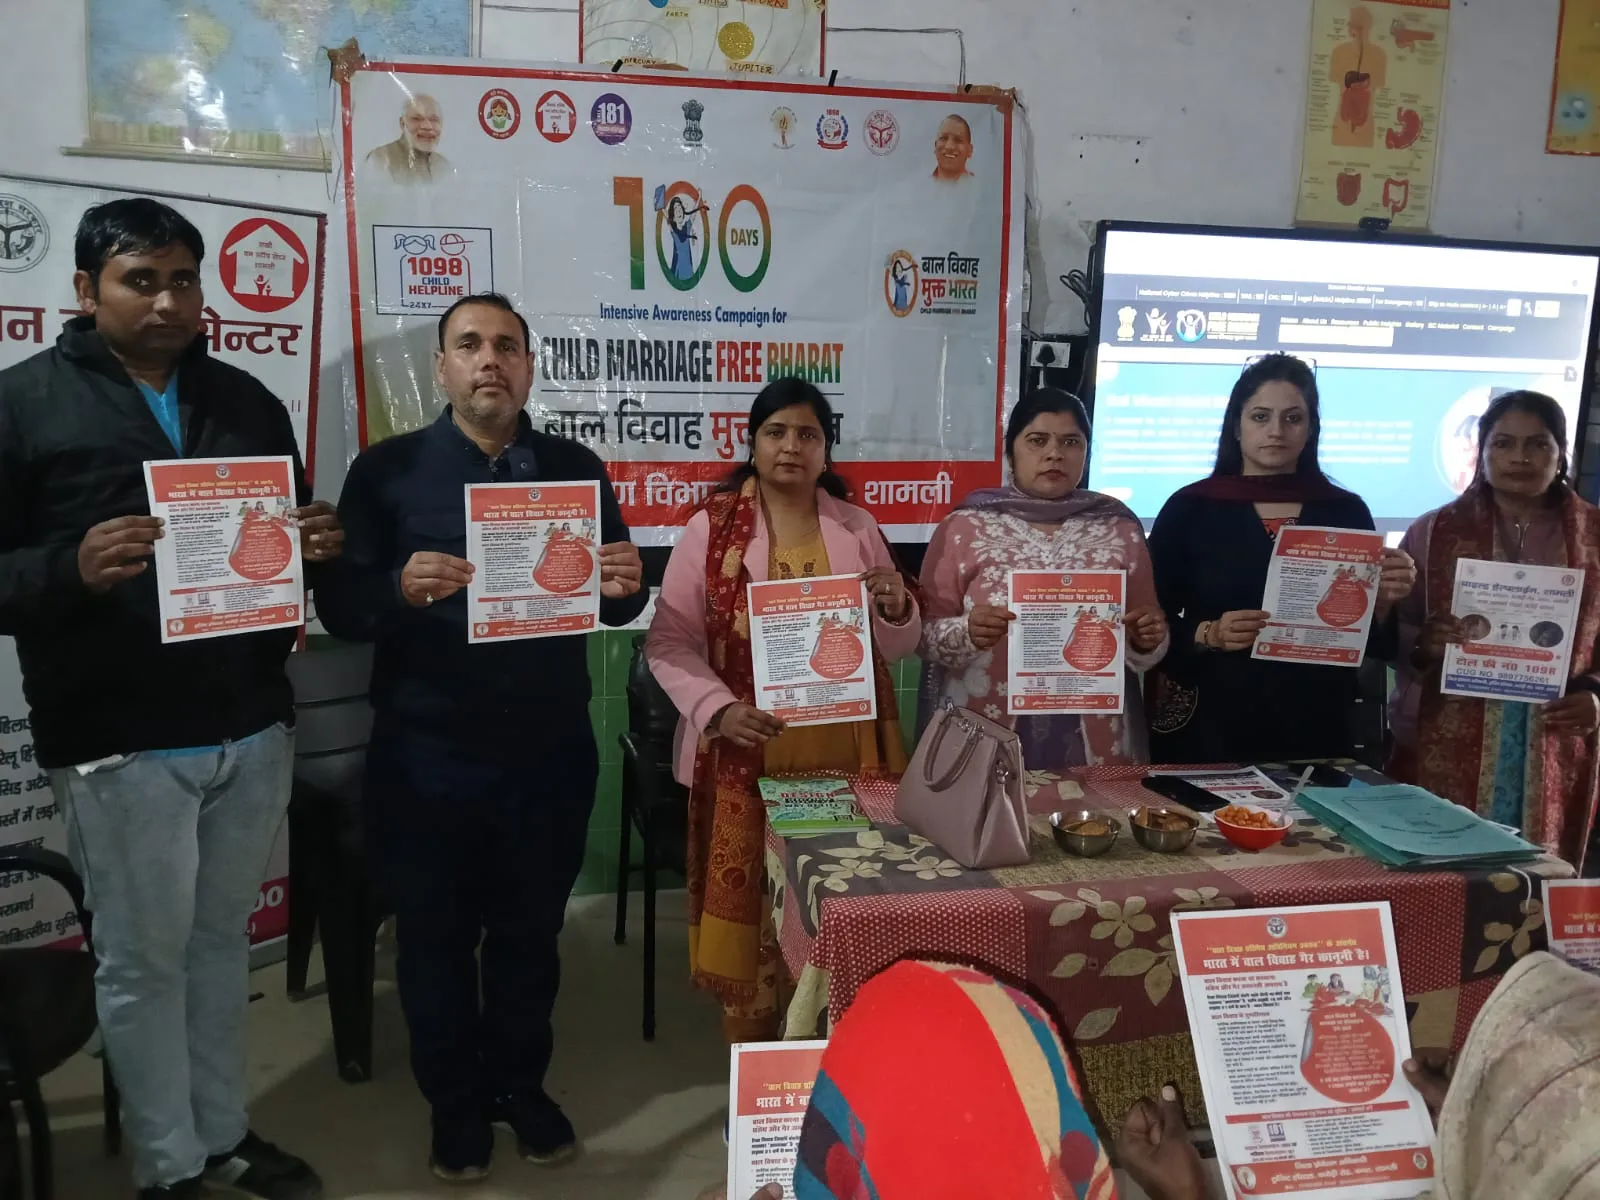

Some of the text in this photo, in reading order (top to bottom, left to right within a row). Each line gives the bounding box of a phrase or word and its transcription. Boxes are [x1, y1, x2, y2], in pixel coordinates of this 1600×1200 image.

[599, 102, 625, 124] 181
[613, 176, 771, 293] 100
[731, 228, 759, 246] DAYS
[407, 257, 463, 276] 1098
[921, 251, 980, 278] बाल विवाह
[408, 285, 464, 296] HELPLINE
[421, 277, 450, 286] CHILD
[921, 278, 979, 308] मुक्त भारत
[600, 302, 788, 328] Intensive Awareness Campaign for
[541, 336, 844, 383] CHILD MARRIAGE FREE BHARAT
[614, 398, 704, 450] विवाह
[864, 471, 954, 506] शामली
[756, 1093, 811, 1108] भारत में बा
